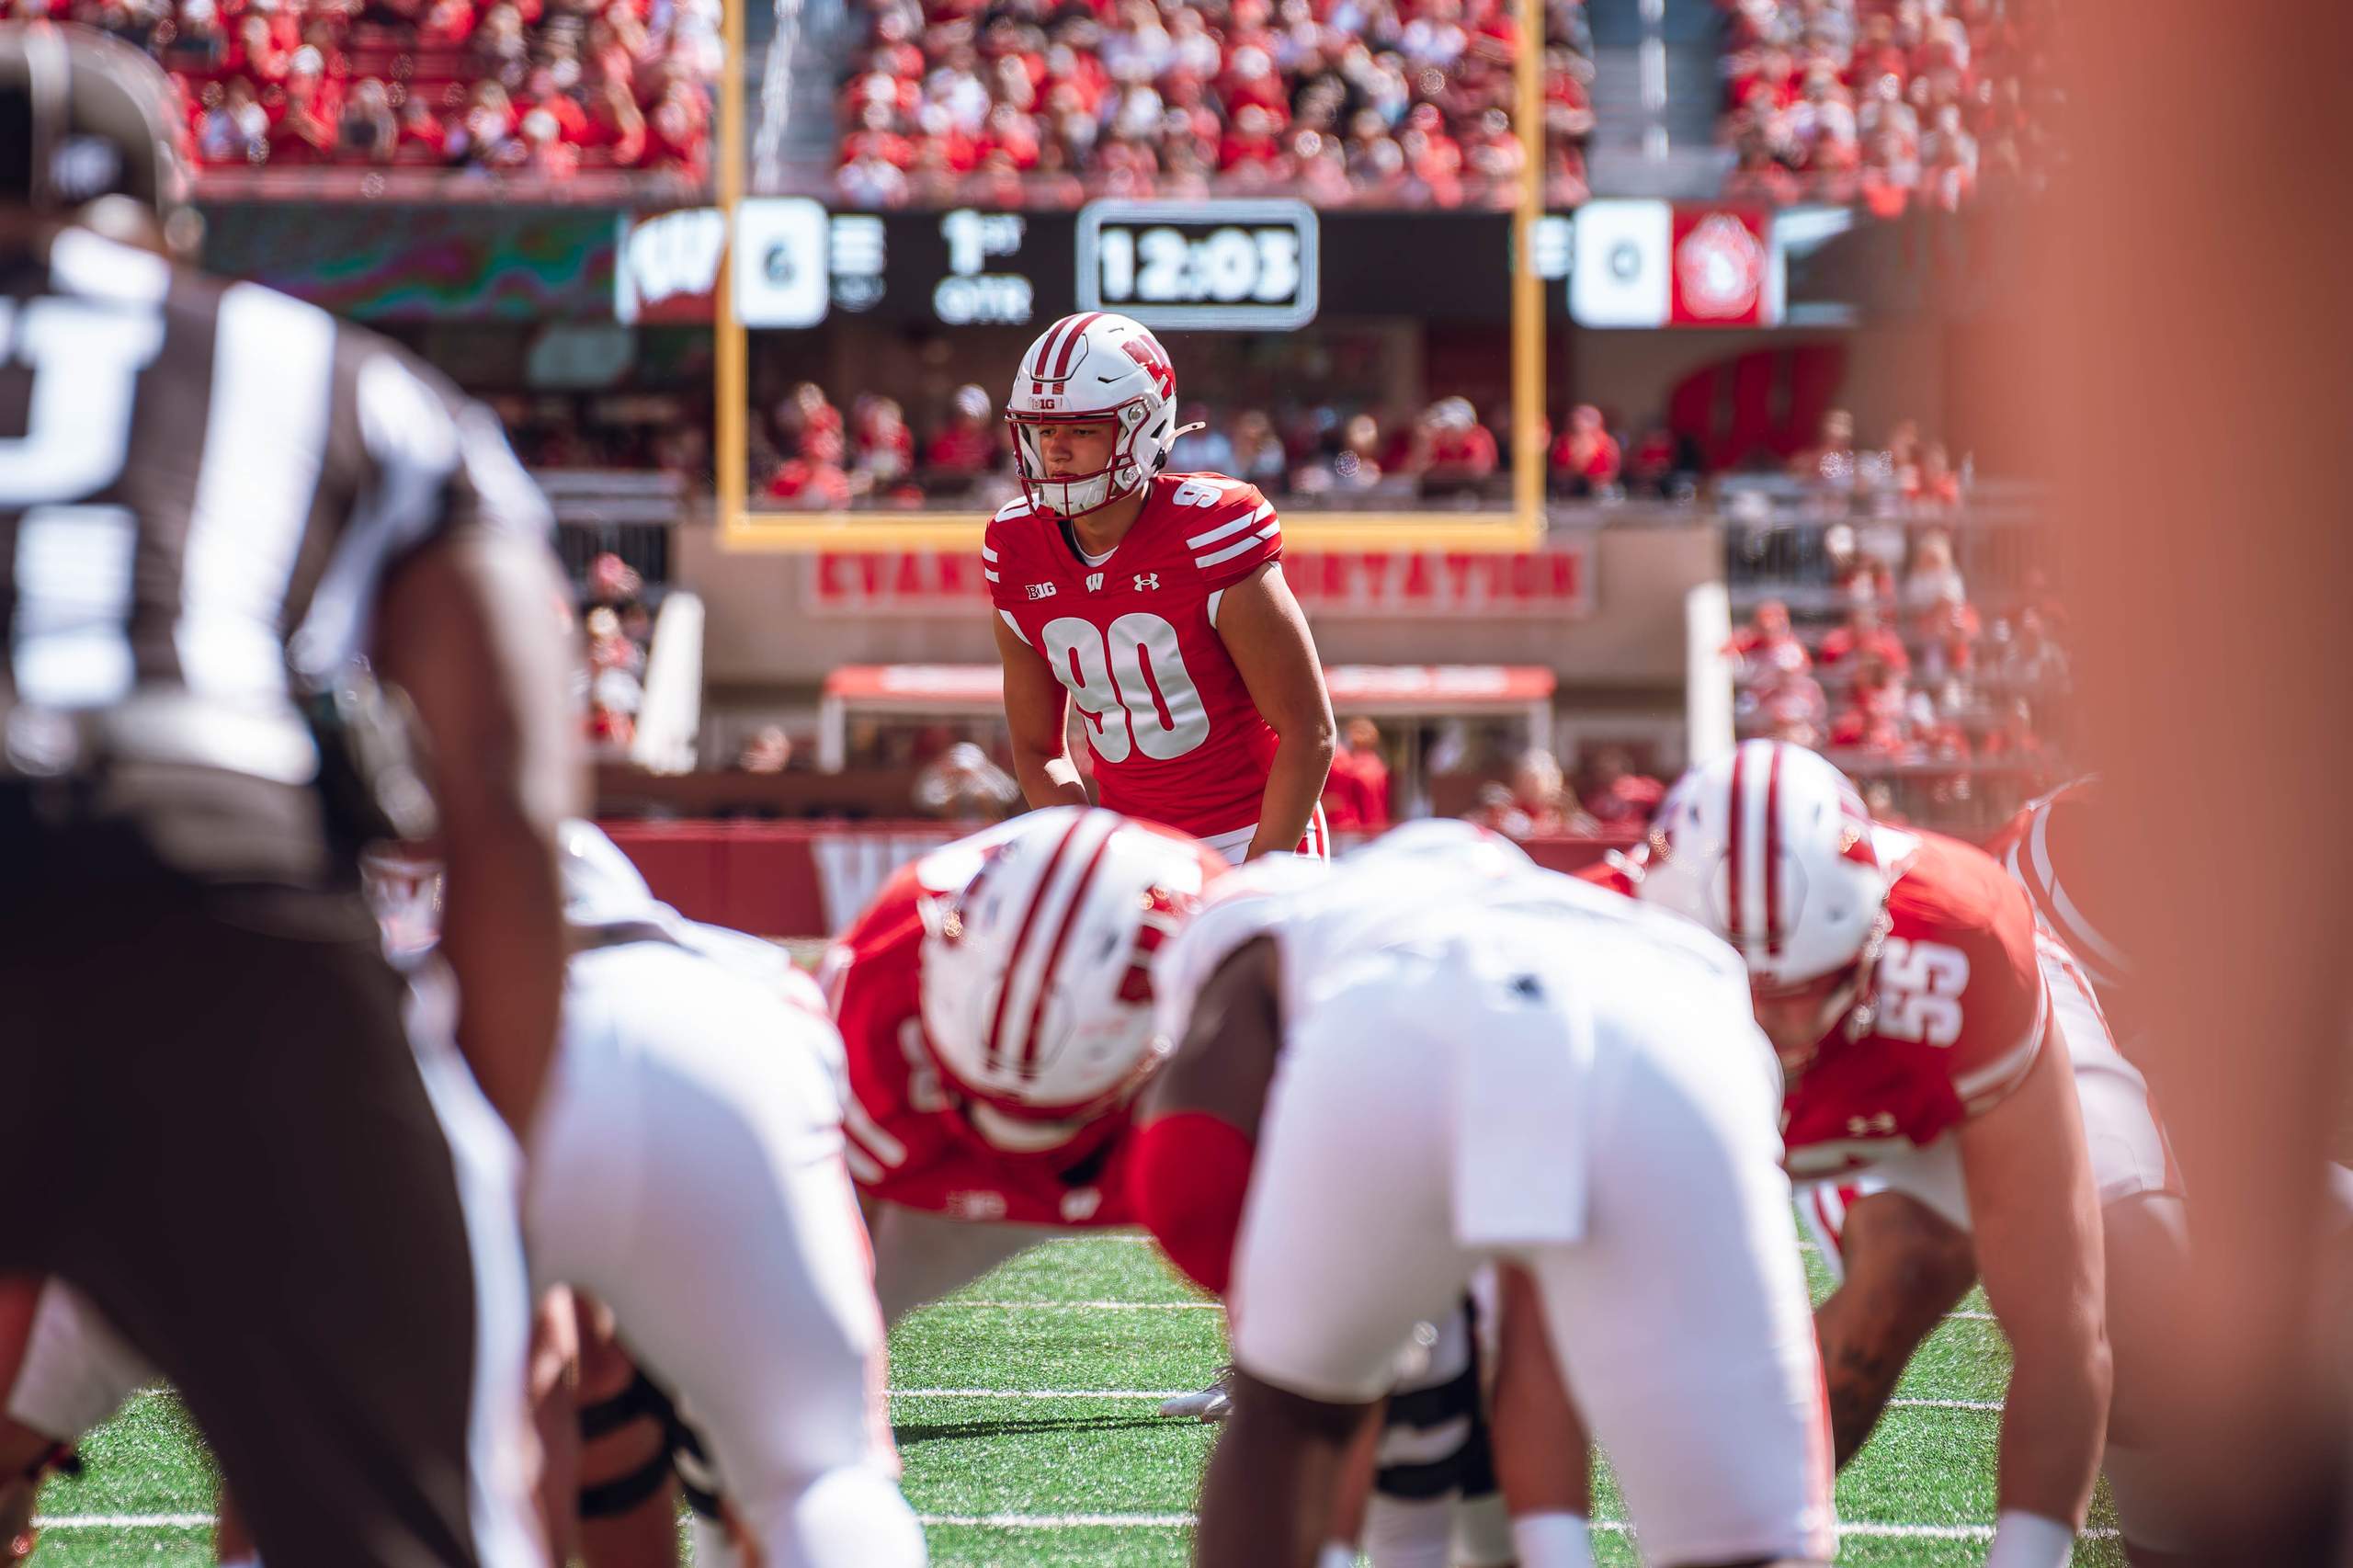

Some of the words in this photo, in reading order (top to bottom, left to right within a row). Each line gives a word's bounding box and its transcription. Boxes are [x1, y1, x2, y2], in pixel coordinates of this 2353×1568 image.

[1101, 226, 1298, 303] 12:03
[1086, 573, 1104, 593] W
[1041, 612, 1211, 764] 90
[1874, 936, 1971, 1048] 55
